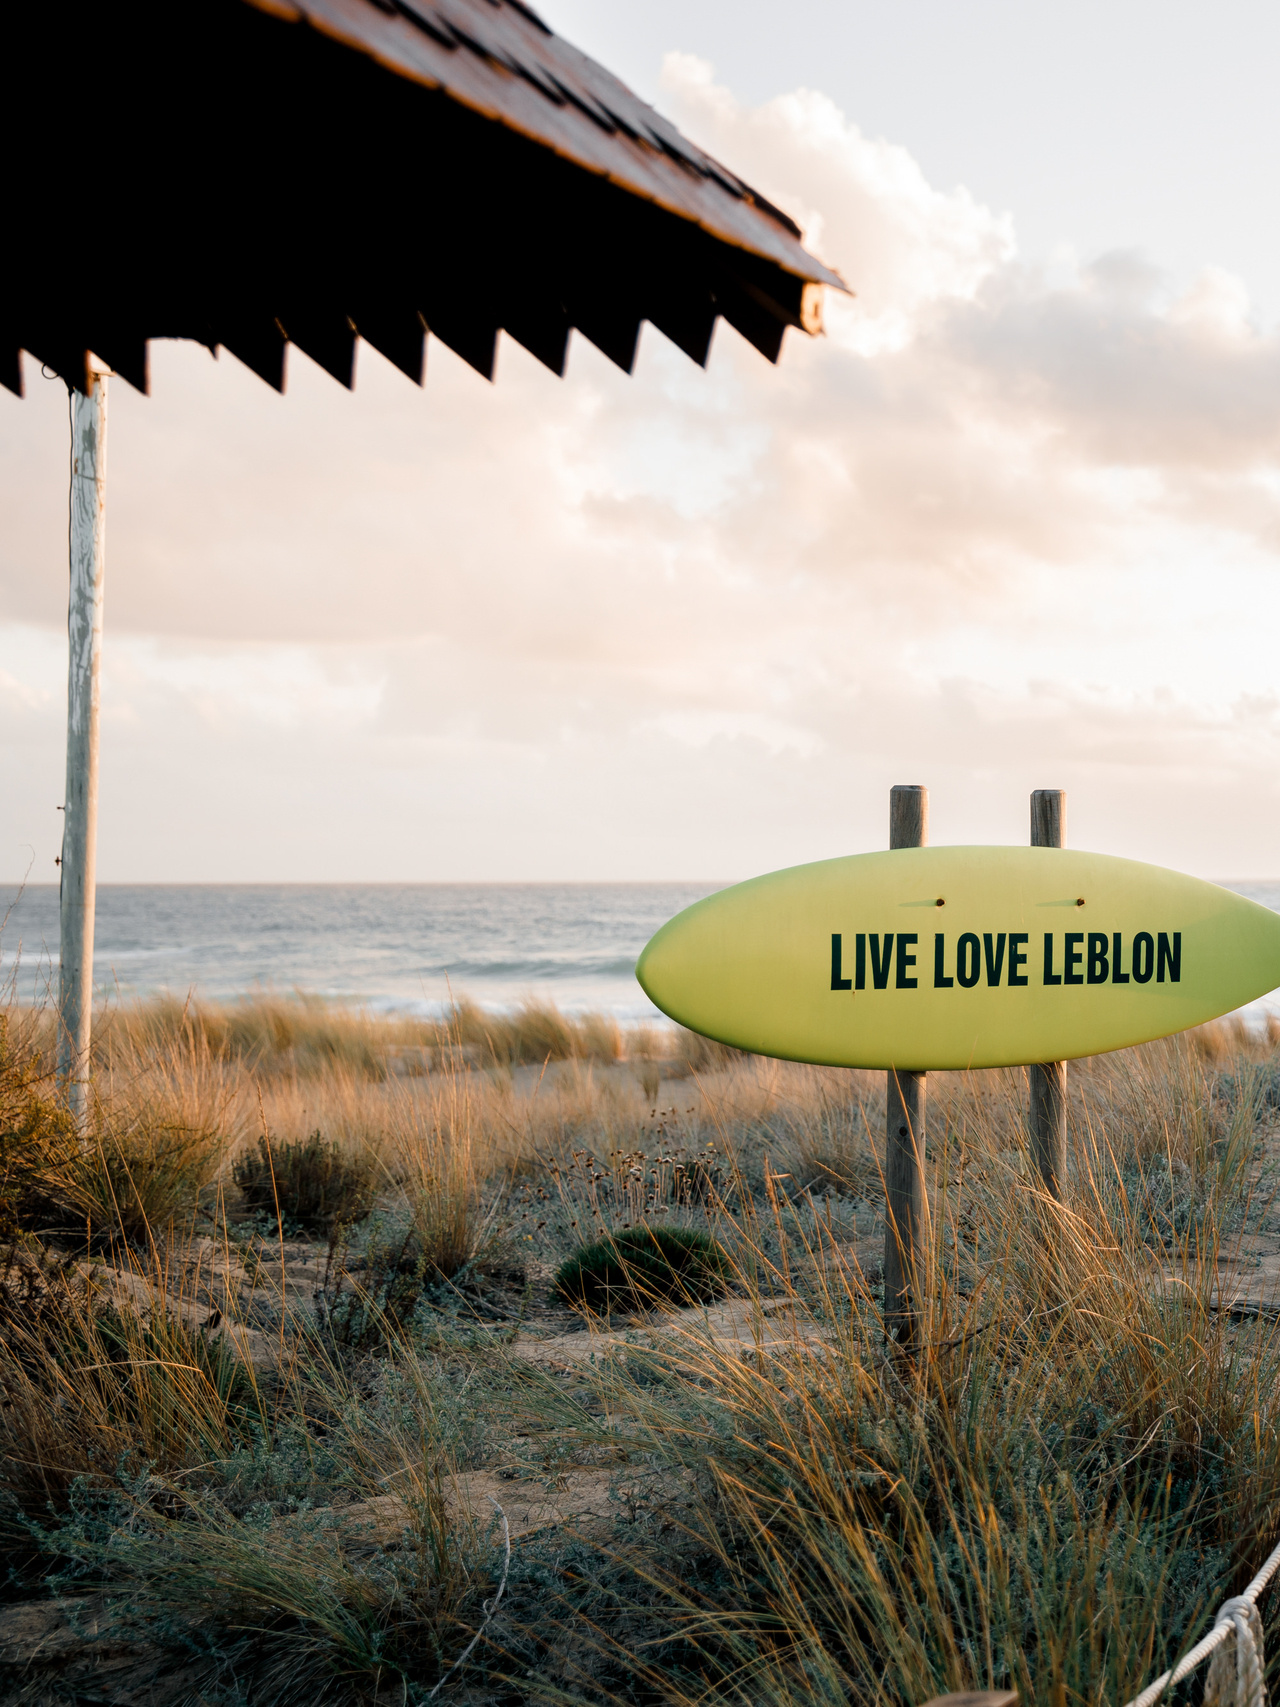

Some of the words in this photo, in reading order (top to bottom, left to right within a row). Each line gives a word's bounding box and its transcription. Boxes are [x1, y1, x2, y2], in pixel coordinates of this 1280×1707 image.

[831, 933, 918, 990] LIVE
[934, 932, 1028, 989] LOVE
[1043, 932, 1182, 985] LEBLON
